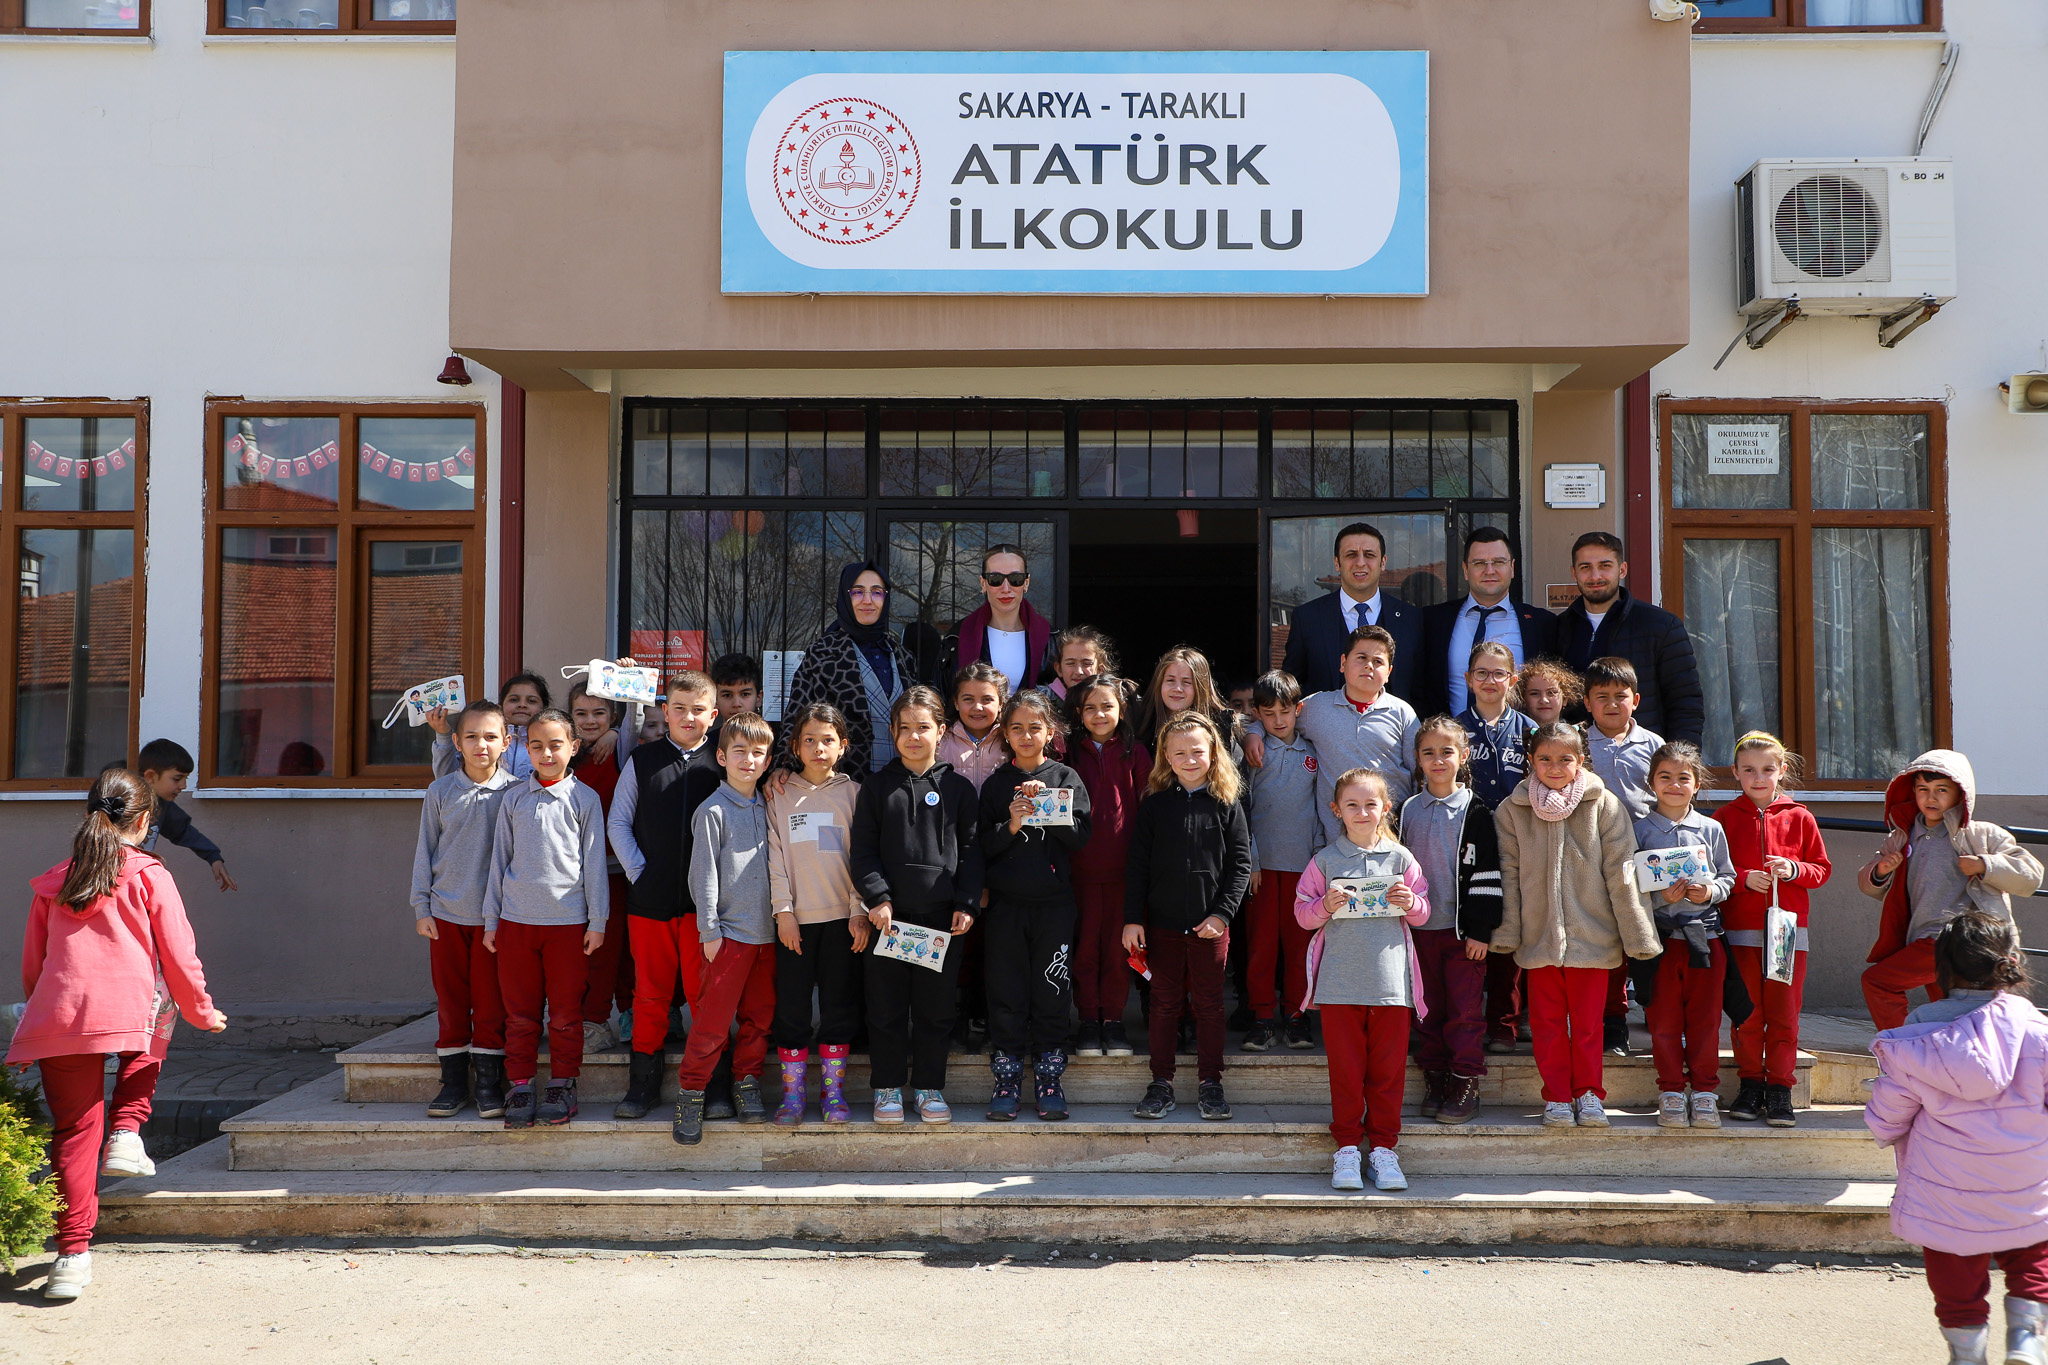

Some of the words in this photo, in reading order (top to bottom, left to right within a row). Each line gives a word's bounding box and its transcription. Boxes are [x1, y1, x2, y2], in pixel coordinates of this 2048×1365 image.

[958, 92, 1092, 119] SAKARYA
[1121, 92, 1246, 119] TARAKLI
[844, 123, 872, 137] MİLLİ
[800, 123, 841, 181] CUMHURİYETİ
[872, 135, 894, 168] EĞİTİM
[950, 133, 1271, 186] ATATÜRK
[803, 183, 836, 216] TÜRKİYE
[857, 171, 894, 216] BAKANLIĞI
[949, 197, 1303, 251] İLKOKULU
[1728, 439, 1759, 447] ÇEVRESİ
[1714, 456, 1774, 464] İZLENMEKTEDİR
